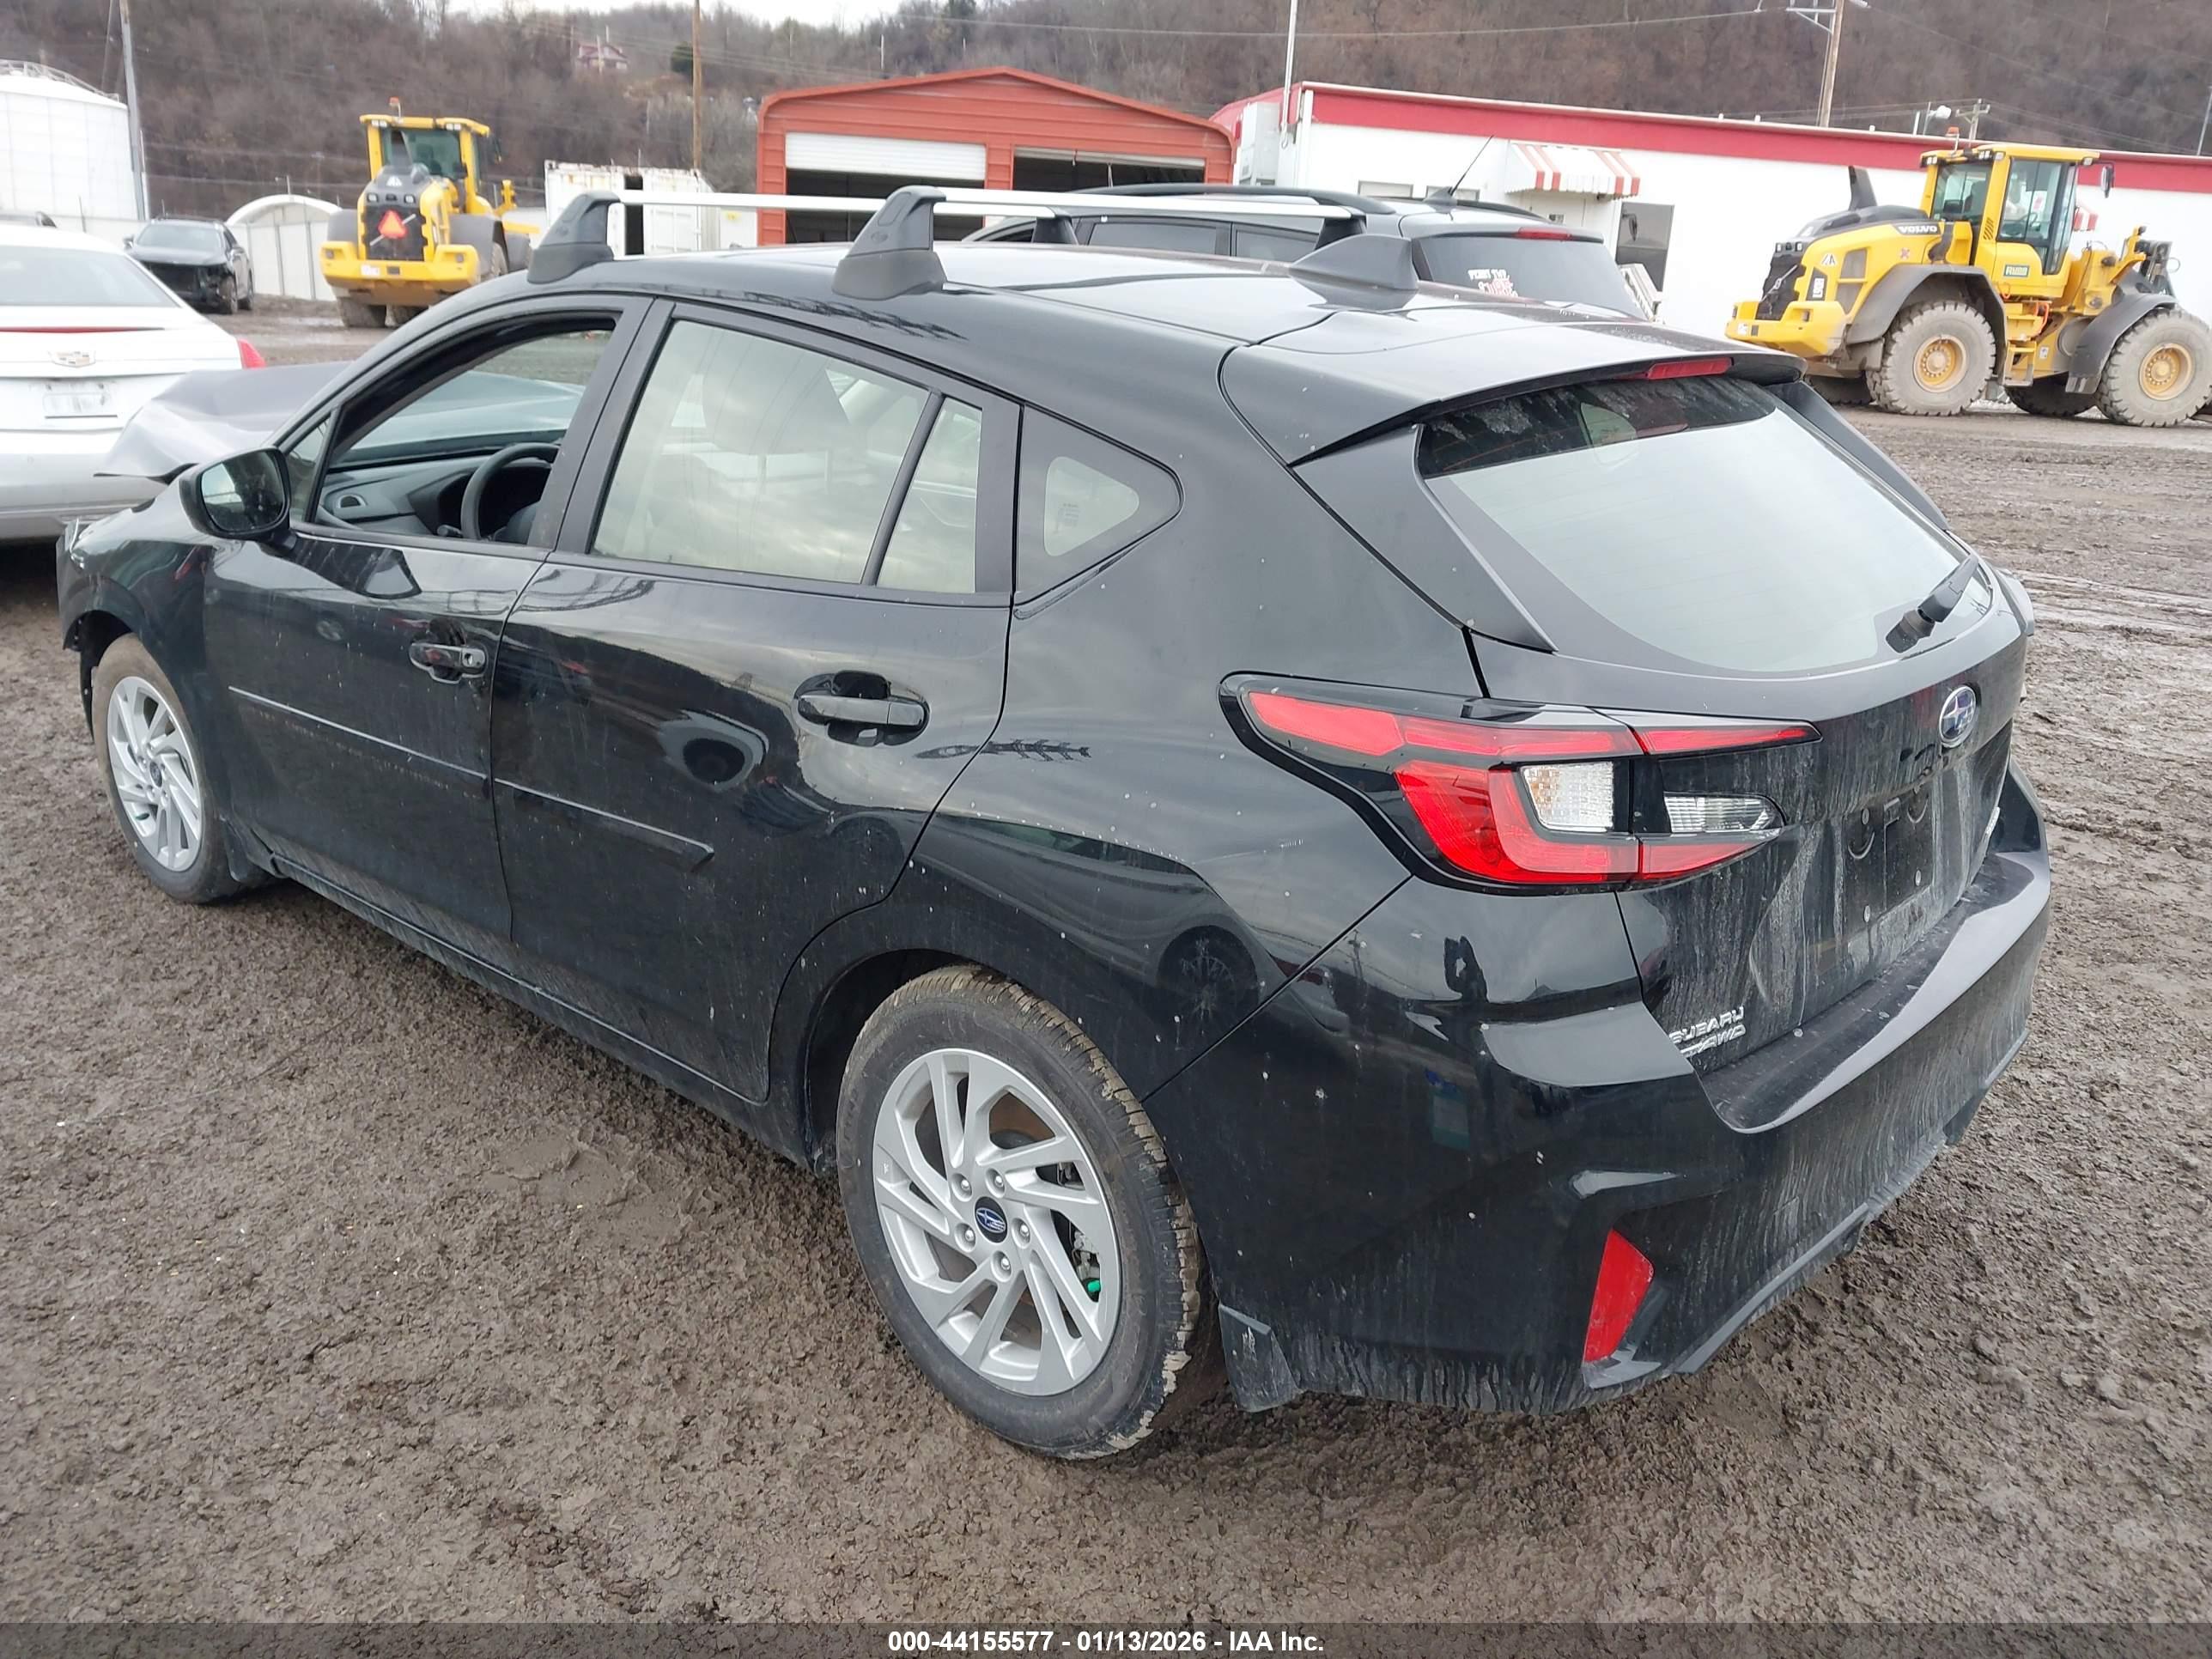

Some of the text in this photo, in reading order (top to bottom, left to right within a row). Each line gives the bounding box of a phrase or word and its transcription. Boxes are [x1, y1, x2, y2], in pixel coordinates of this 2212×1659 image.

[1898, 225, 1938, 234] VOLVO
[1668, 1006, 1744, 1044] SUBARU
[1697, 1024, 1746, 1054] AWD
